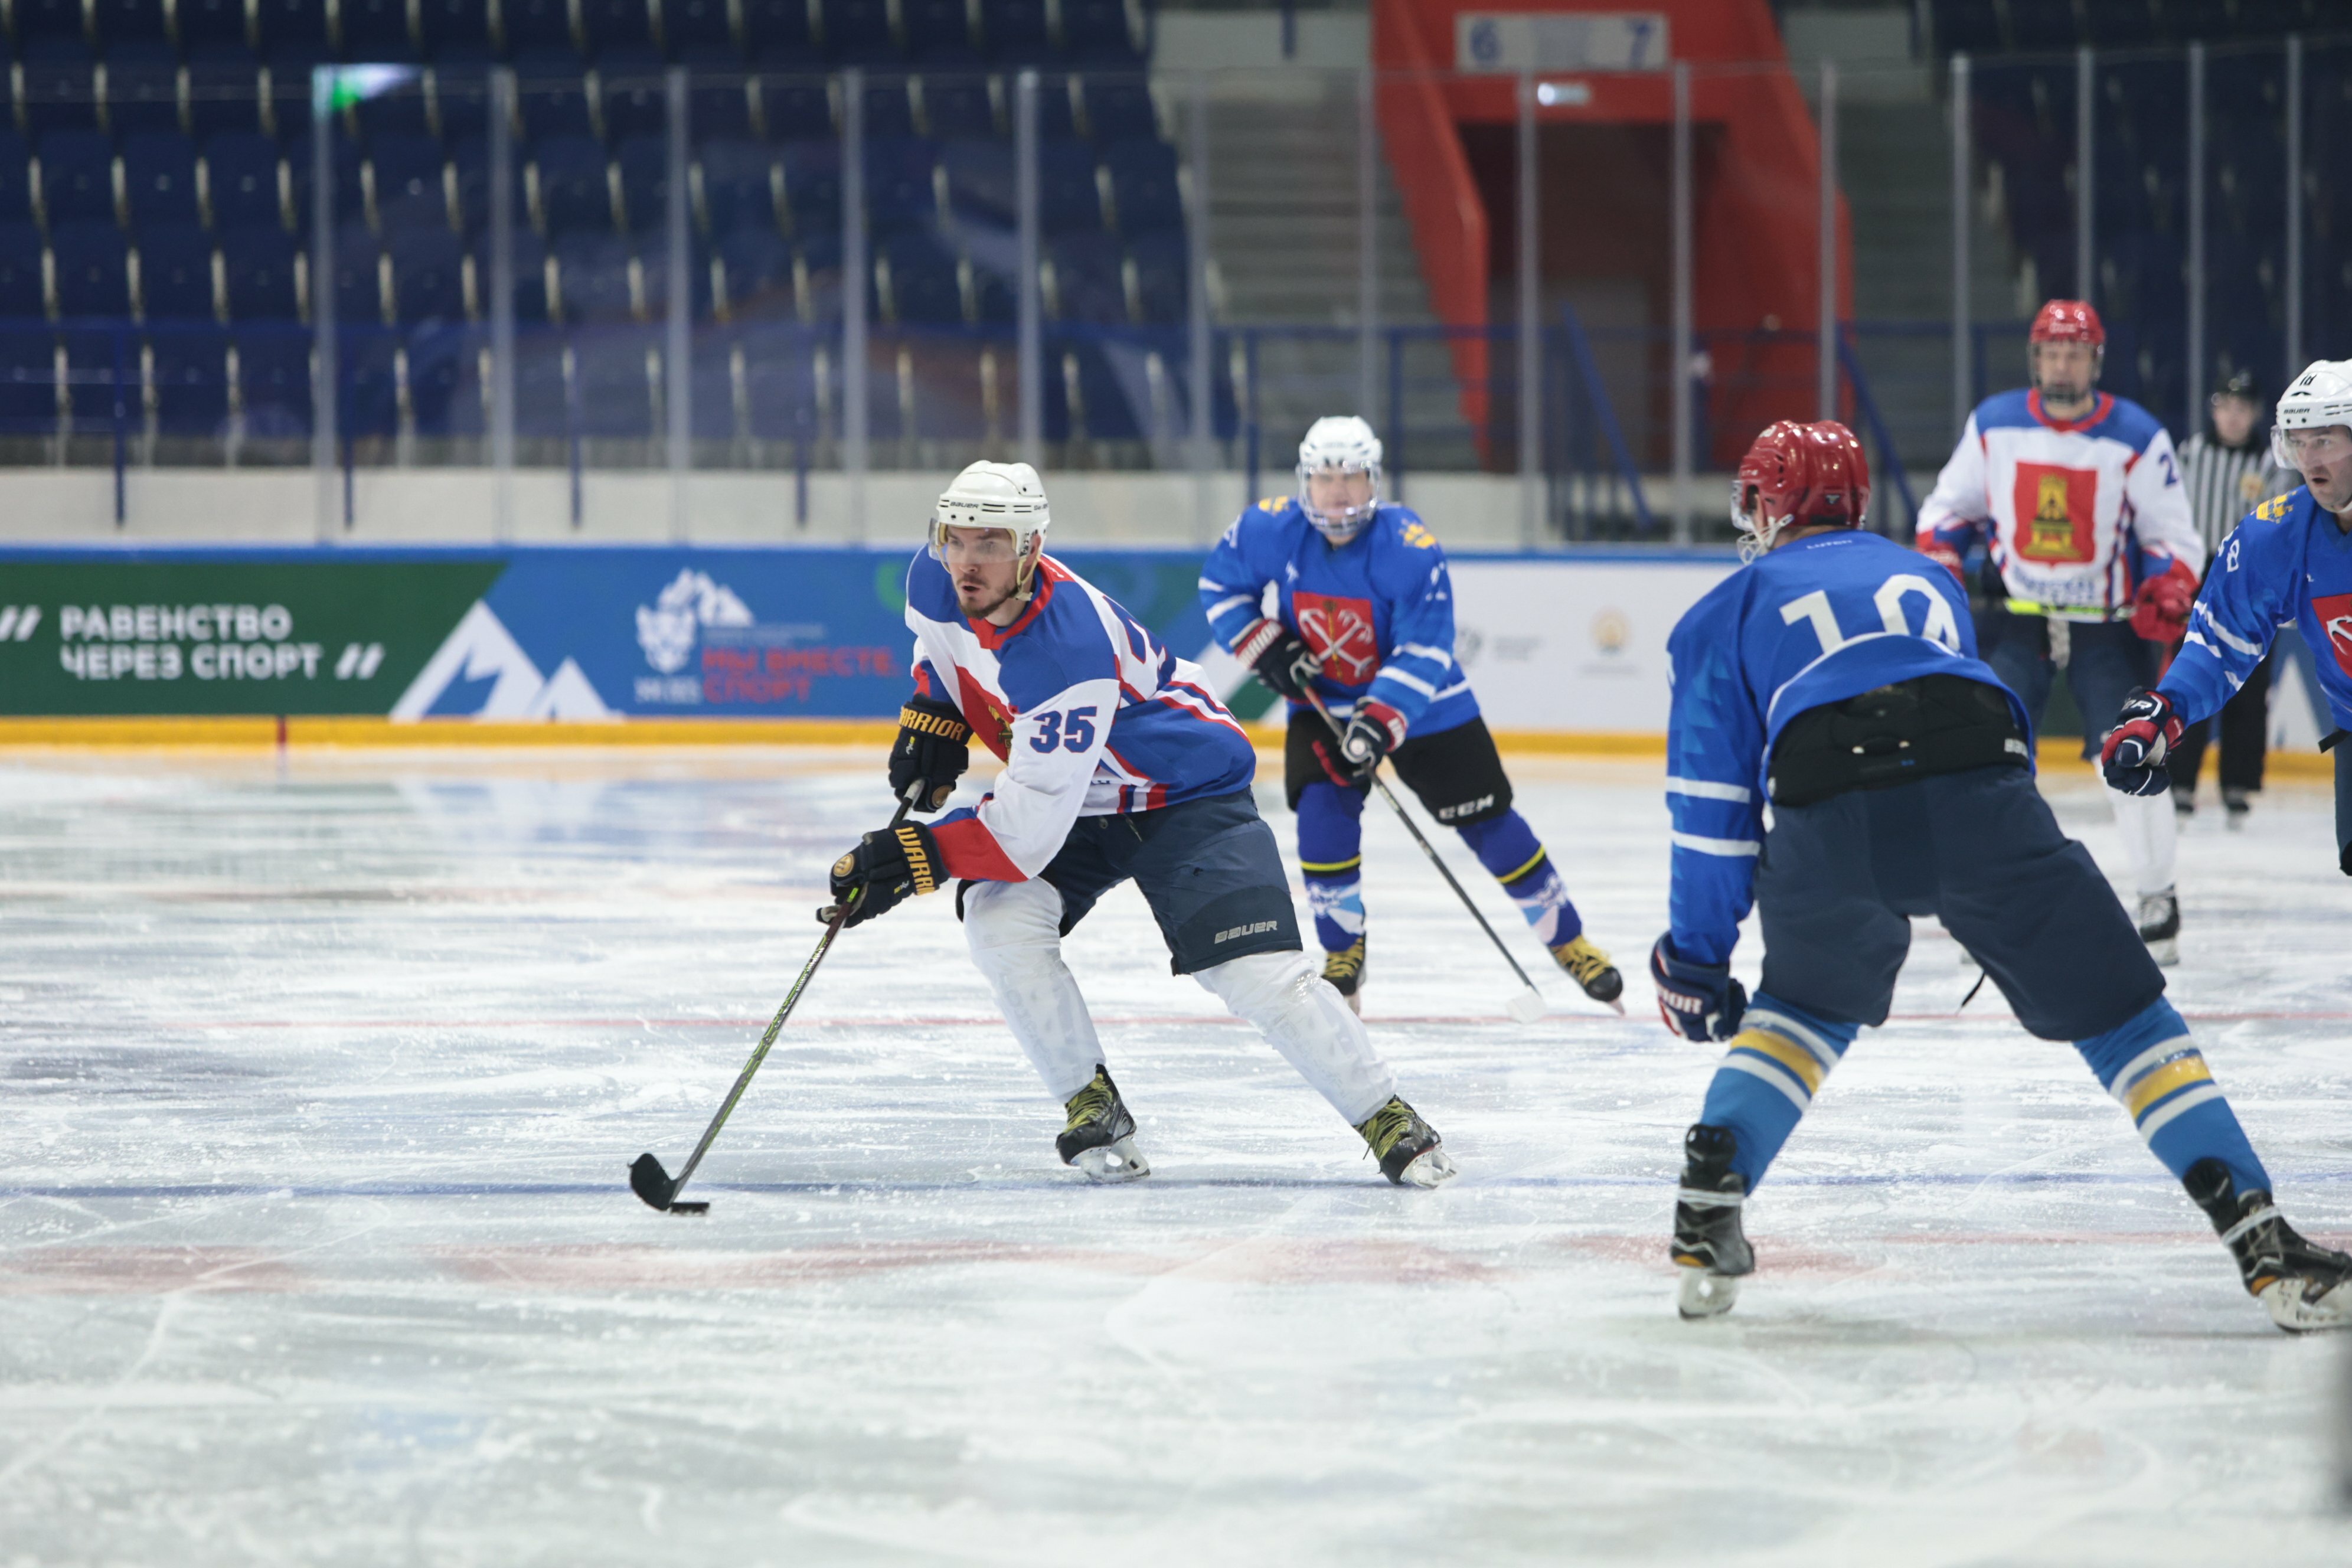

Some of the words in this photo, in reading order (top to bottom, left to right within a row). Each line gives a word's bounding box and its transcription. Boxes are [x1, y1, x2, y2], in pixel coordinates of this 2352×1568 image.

[60, 604, 293, 642] РАВЕНСТВО
[60, 644, 183, 680] ЧЕРЕЗ
[191, 644, 323, 680] СПОРТ
[899, 705, 965, 740] ARRIOR
[1030, 706, 1097, 754] 35
[1214, 920, 1278, 945] BAUER
